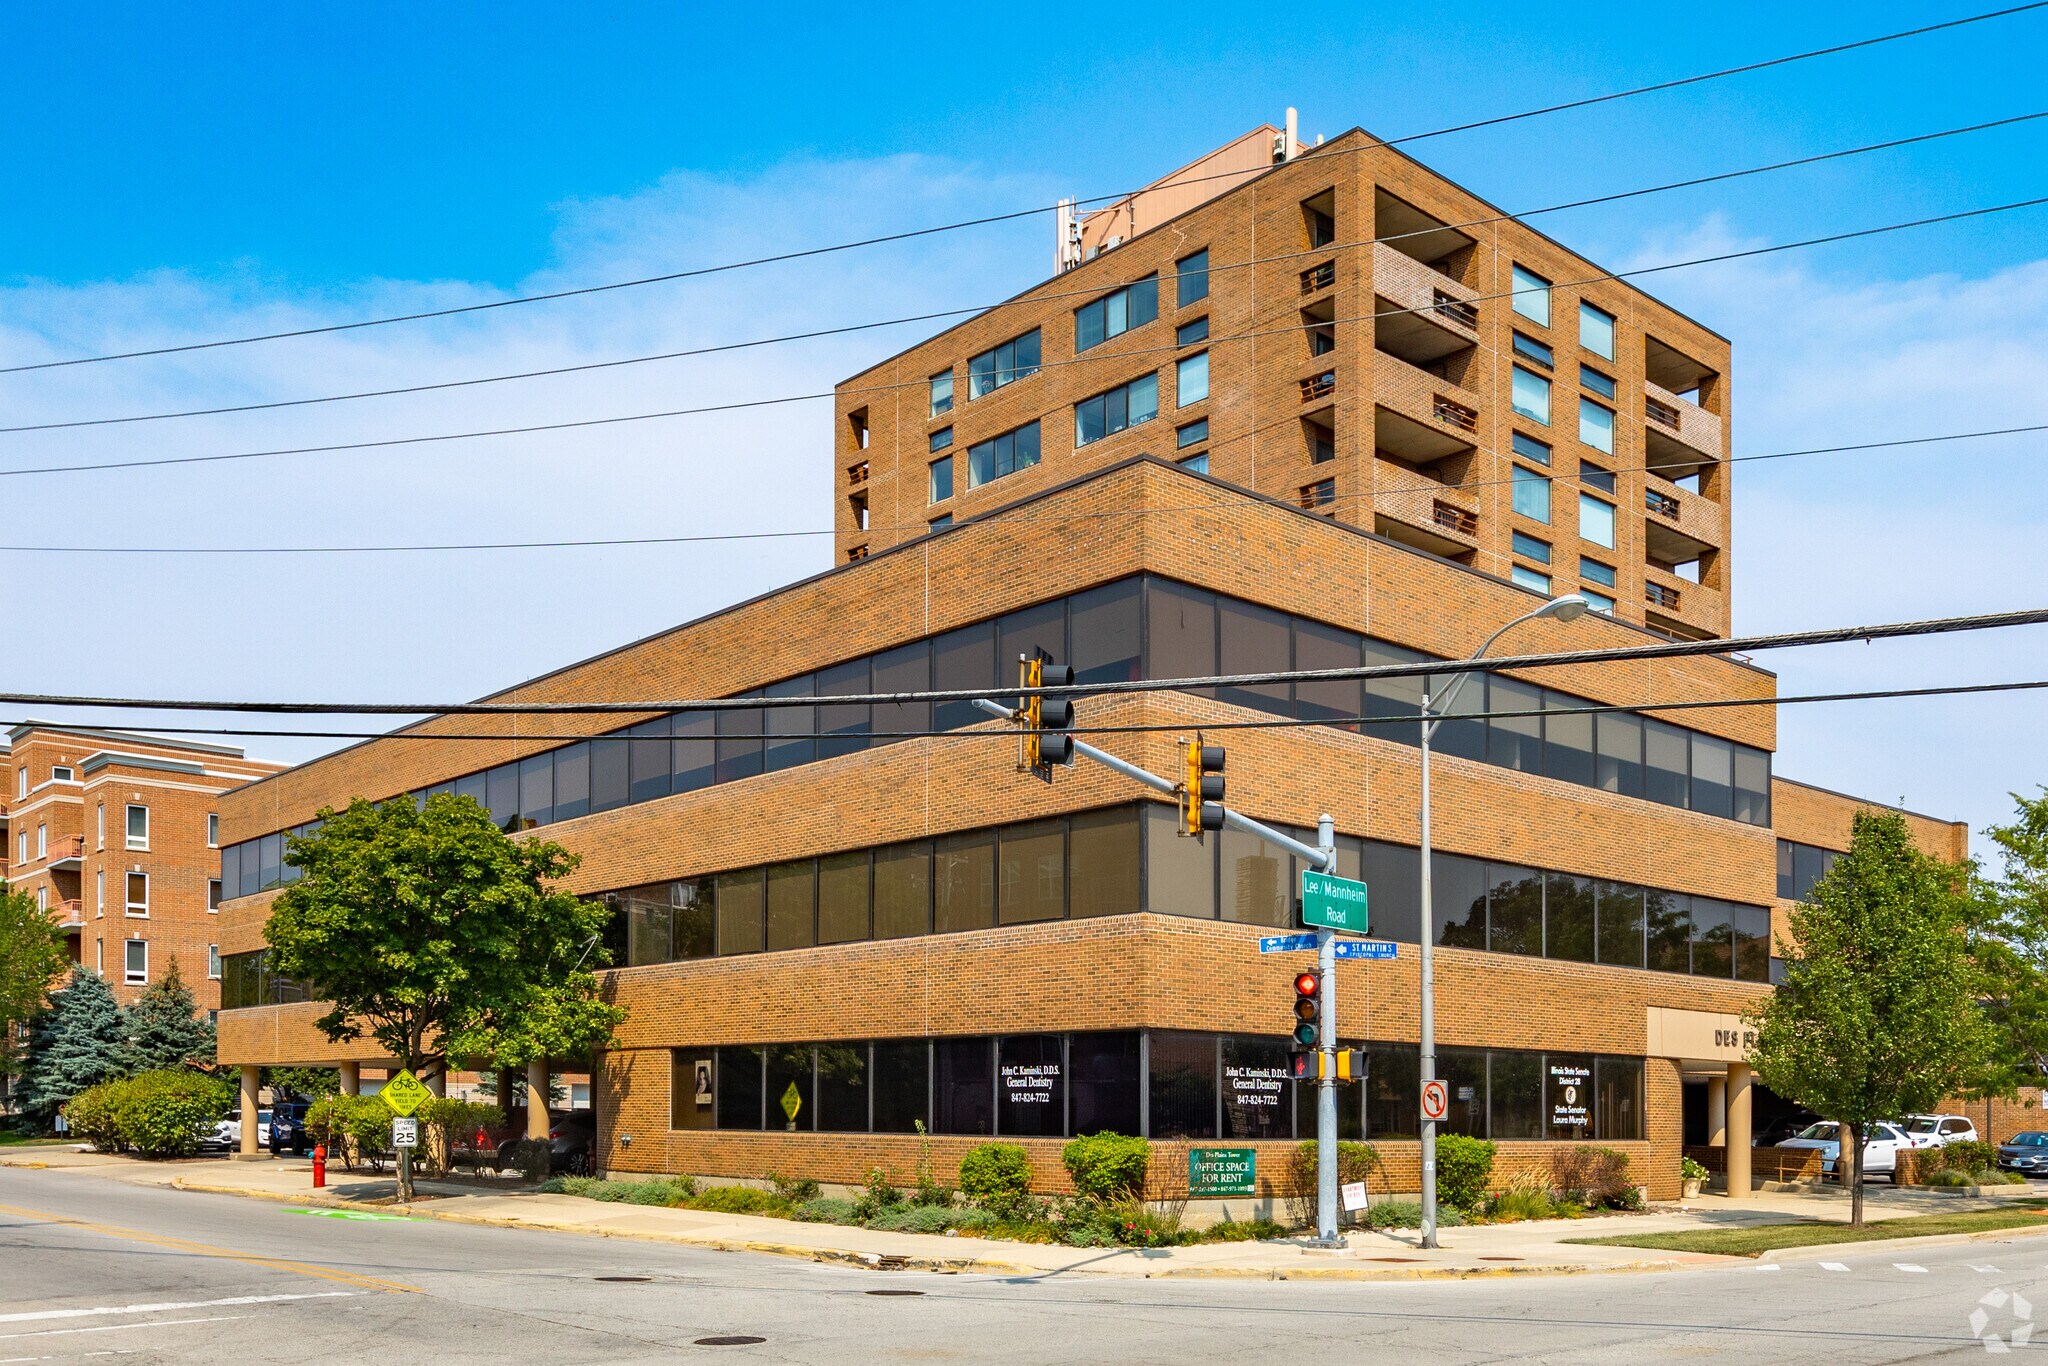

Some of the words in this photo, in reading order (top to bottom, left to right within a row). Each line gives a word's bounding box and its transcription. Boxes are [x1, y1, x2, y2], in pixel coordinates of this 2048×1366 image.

[1326, 906, 1346, 924] Road
[1295, 942, 1312, 950] Church
[1715, 1029, 1738, 1047] DES
[1001, 1065, 1013, 1076] John
[1013, 1065, 1019, 1076] C.
[1043, 1065, 1060, 1075] D.D.S.
[1226, 1066, 1239, 1077] John
[1238, 1067, 1246, 1077] C.
[1271, 1068, 1288, 1078] D.D.S.
[1564, 1066, 1575, 1075] State
[1575, 1067, 1590, 1076] Senate
[1006, 1076, 1028, 1088] General
[1028, 1076, 1054, 1090] Dentistry
[1232, 1077, 1256, 1090] General
[1256, 1078, 1283, 1093] Dentistry
[1559, 1077, 1575, 1085] District
[1011, 1092, 1050, 1103] 847-824-7722
[1237, 1094, 1278, 1106] 847-824-7722
[1554, 1105, 1568, 1114] State
[1568, 1105, 1587, 1114] Senator
[1553, 1115, 1569, 1124] Laura
[1569, 1115, 1588, 1126] Murphy
[396, 1132, 415, 1143] 25
[1194, 1161, 1225, 1172] OFFICE
[1225, 1161, 1250, 1172] SPACE
[1202, 1173, 1219, 1183] FOR
[1220, 1173, 1243, 1183] RENT
